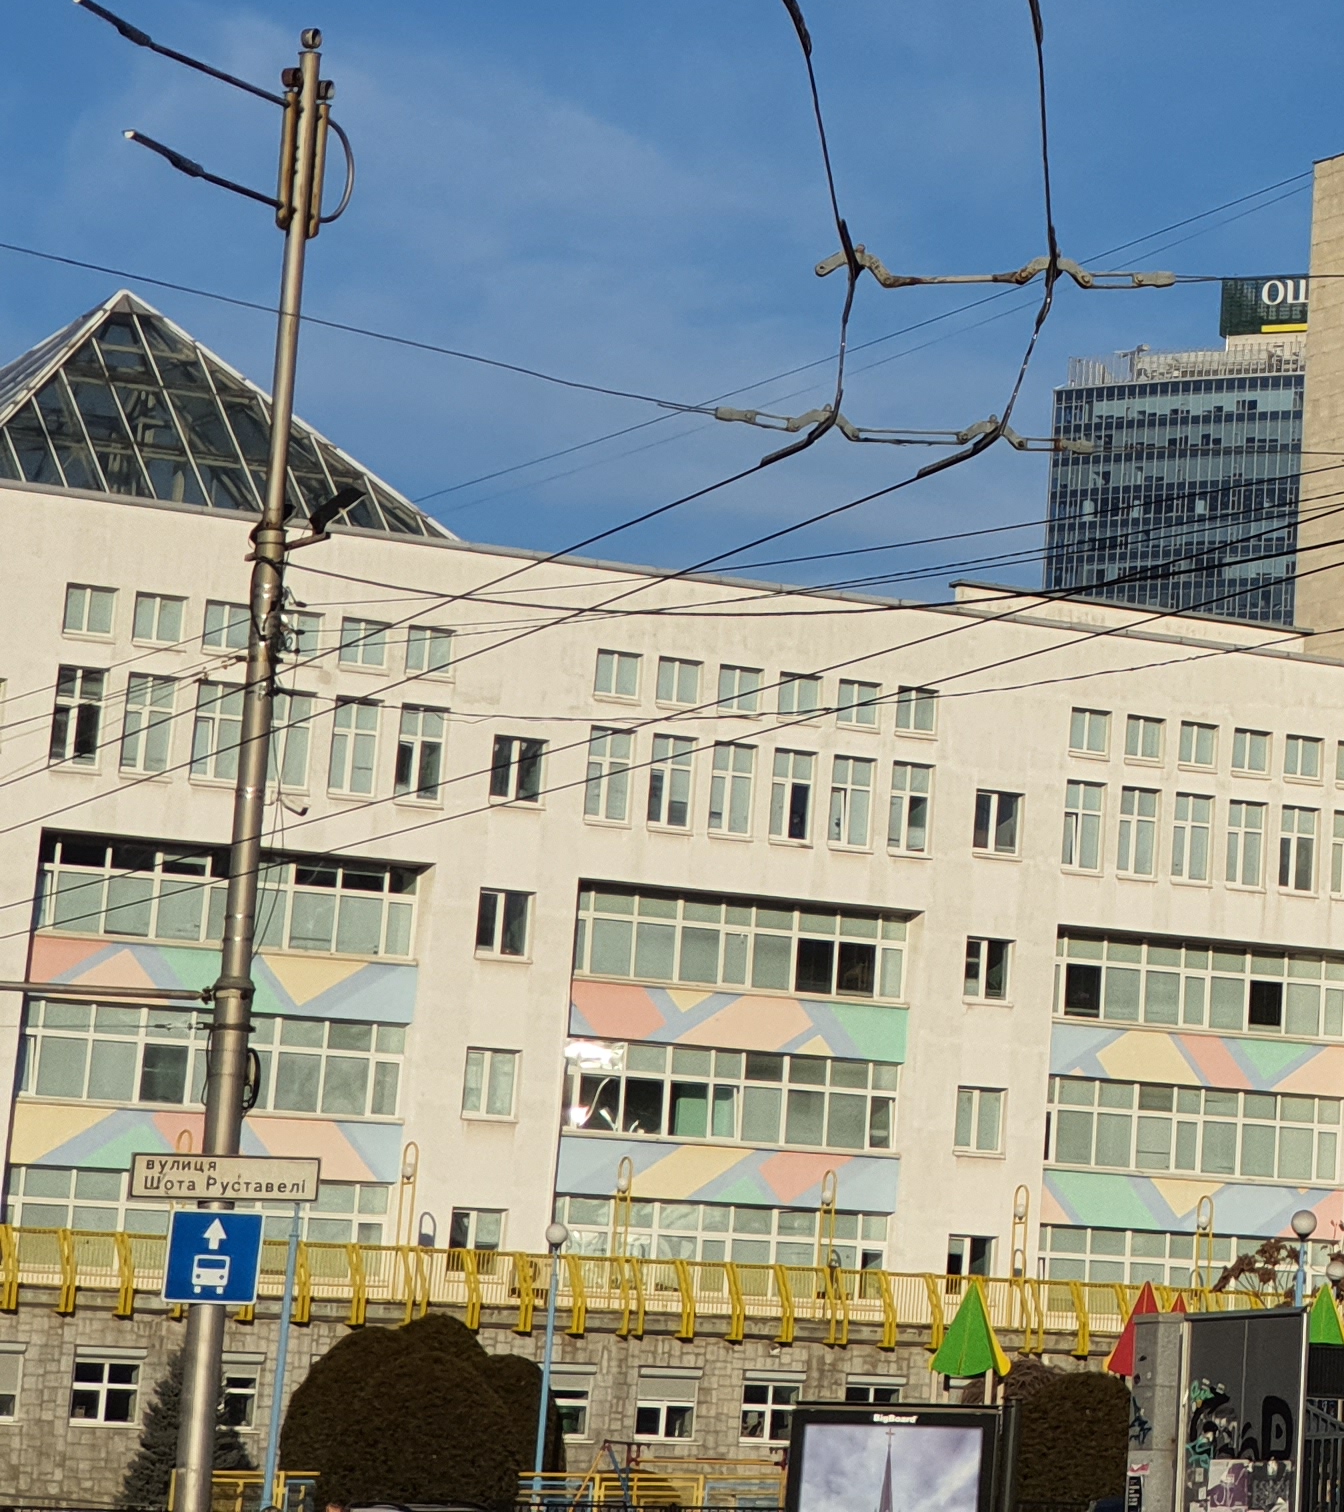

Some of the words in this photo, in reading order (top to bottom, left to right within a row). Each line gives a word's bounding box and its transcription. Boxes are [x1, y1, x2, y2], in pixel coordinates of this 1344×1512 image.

[145, 1159, 217, 1174] вулиця
[143, 1175, 196, 1191] Шота
[205, 1174, 306, 1196] Руставелі
[873, 1413, 918, 1424] BigBoard
